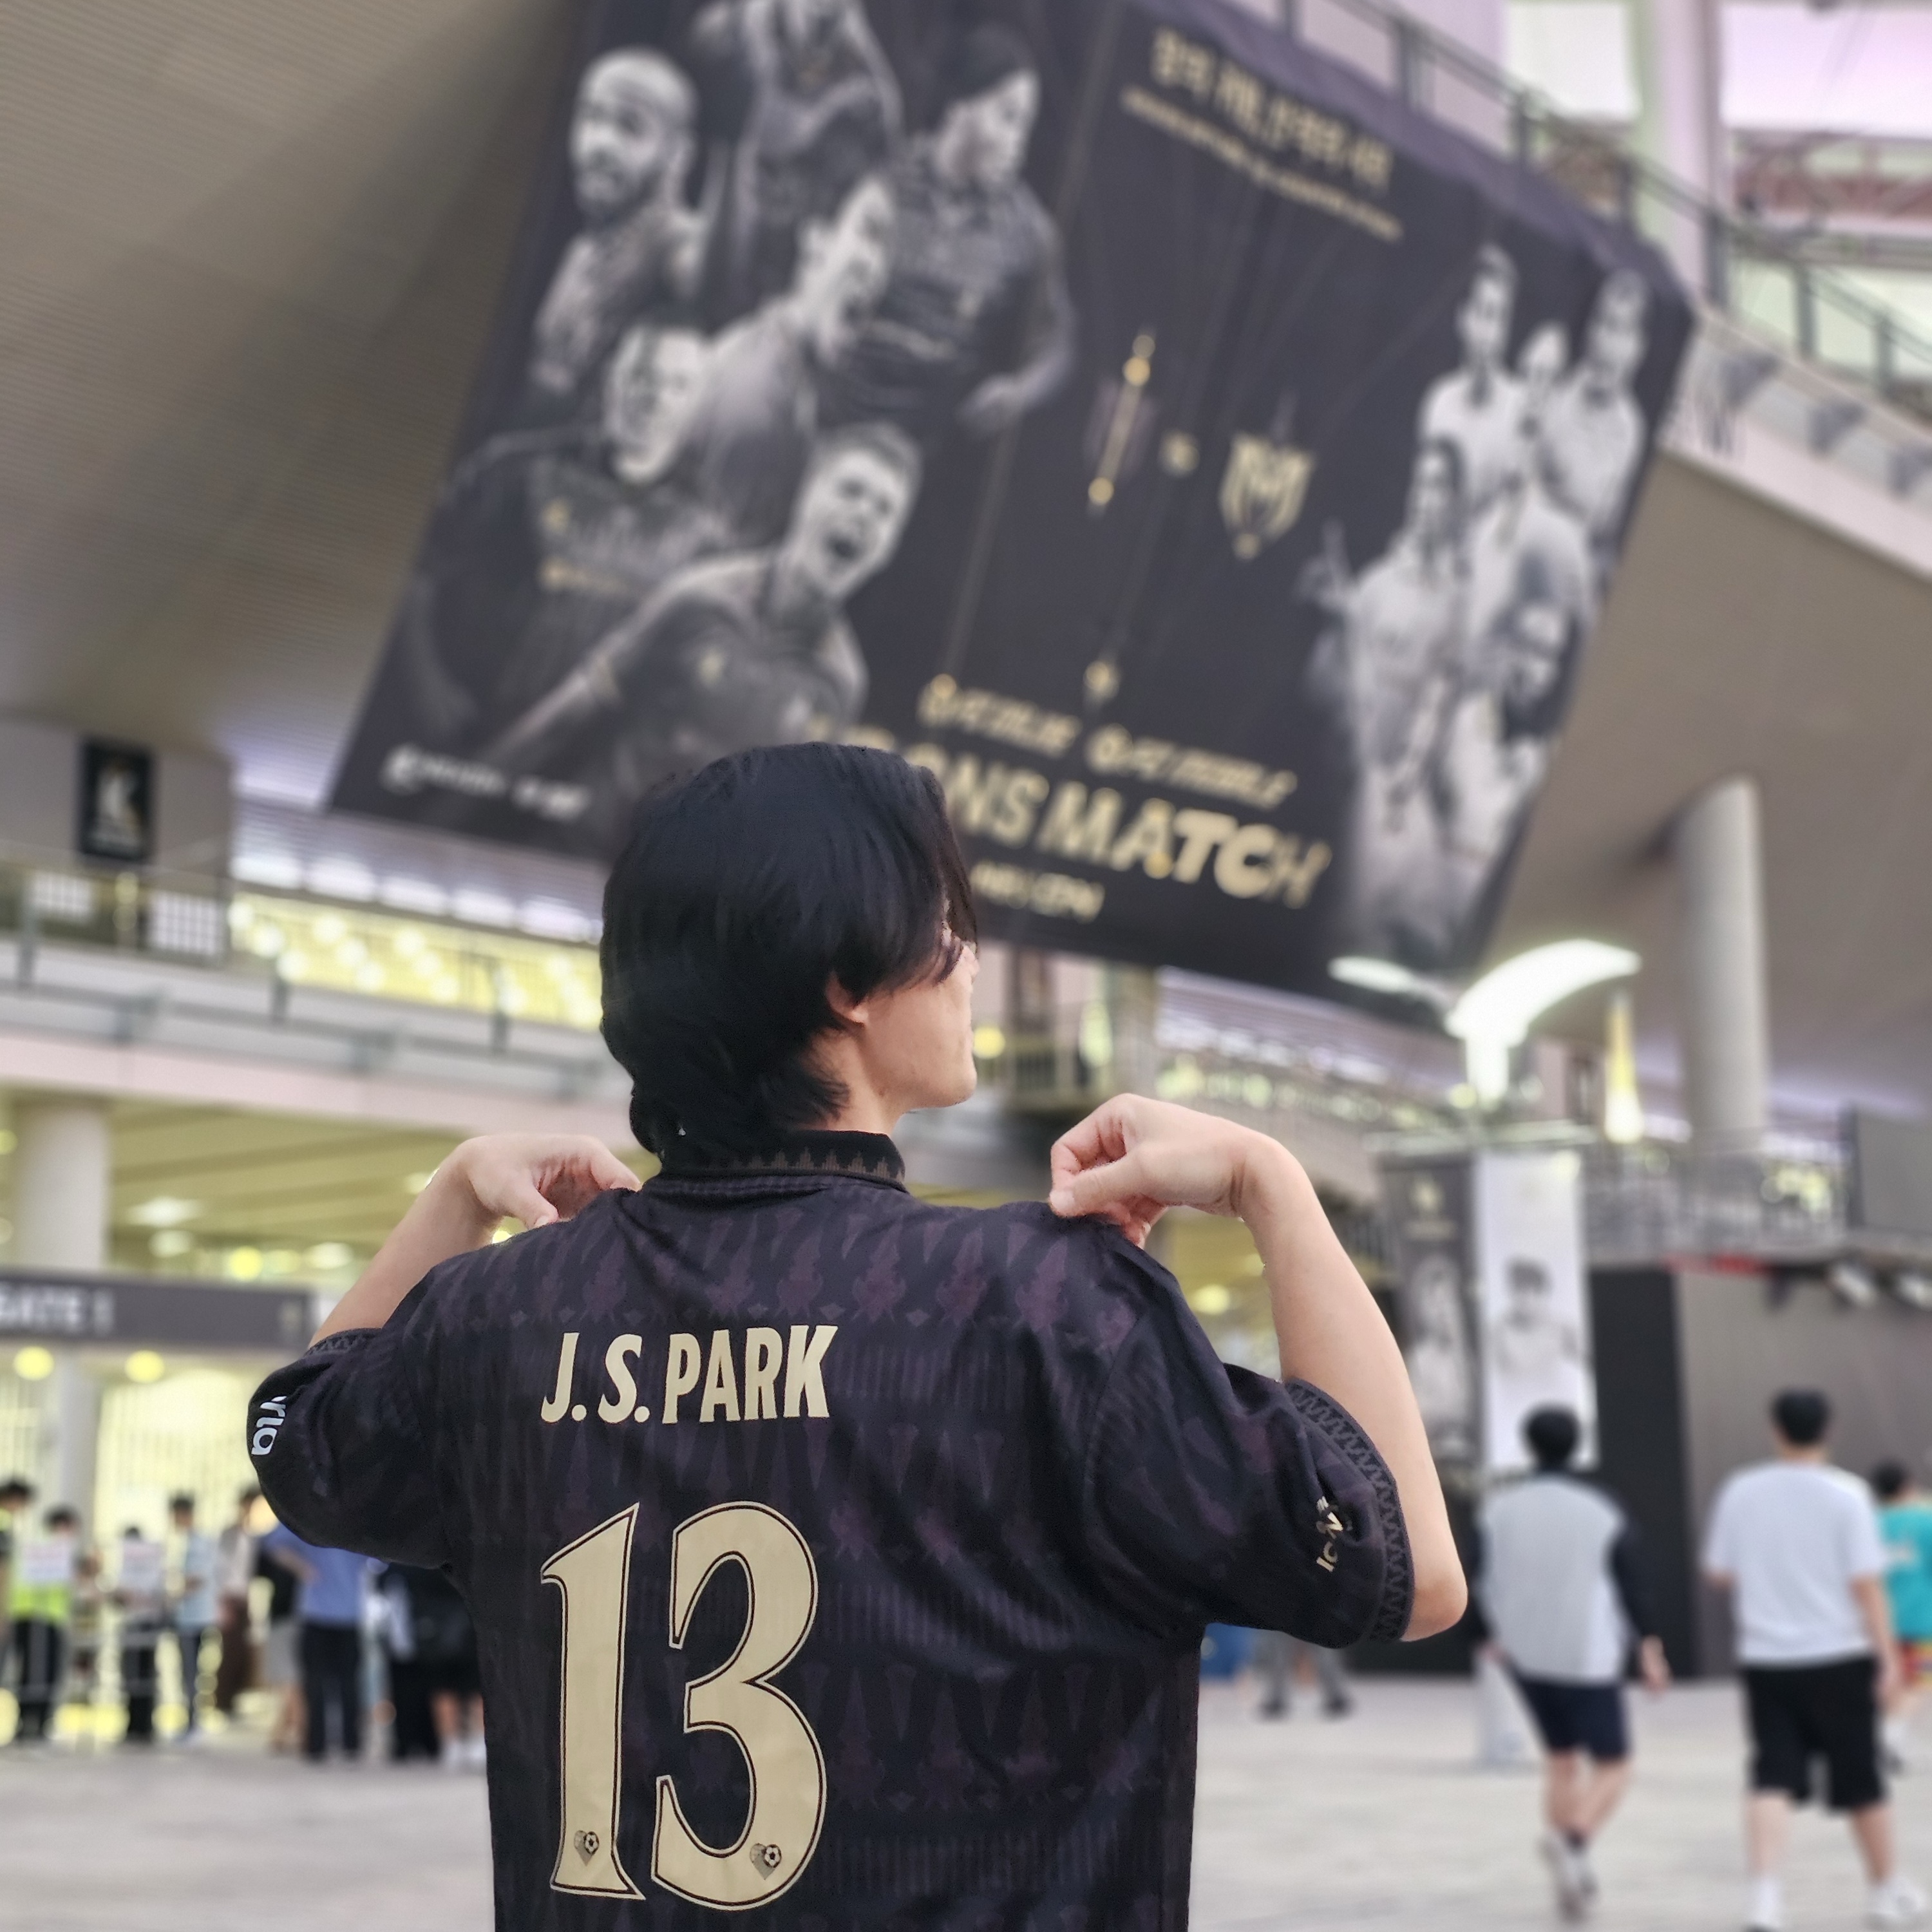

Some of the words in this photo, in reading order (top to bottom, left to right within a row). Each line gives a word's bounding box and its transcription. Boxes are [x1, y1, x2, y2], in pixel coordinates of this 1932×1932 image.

[1038, 781, 1332, 909] MATCH
[541, 1332, 587, 1423] J.
[598, 1333, 650, 1424] S.
[661, 1324, 838, 1424] PARK
[541, 1501, 827, 1911] 13
